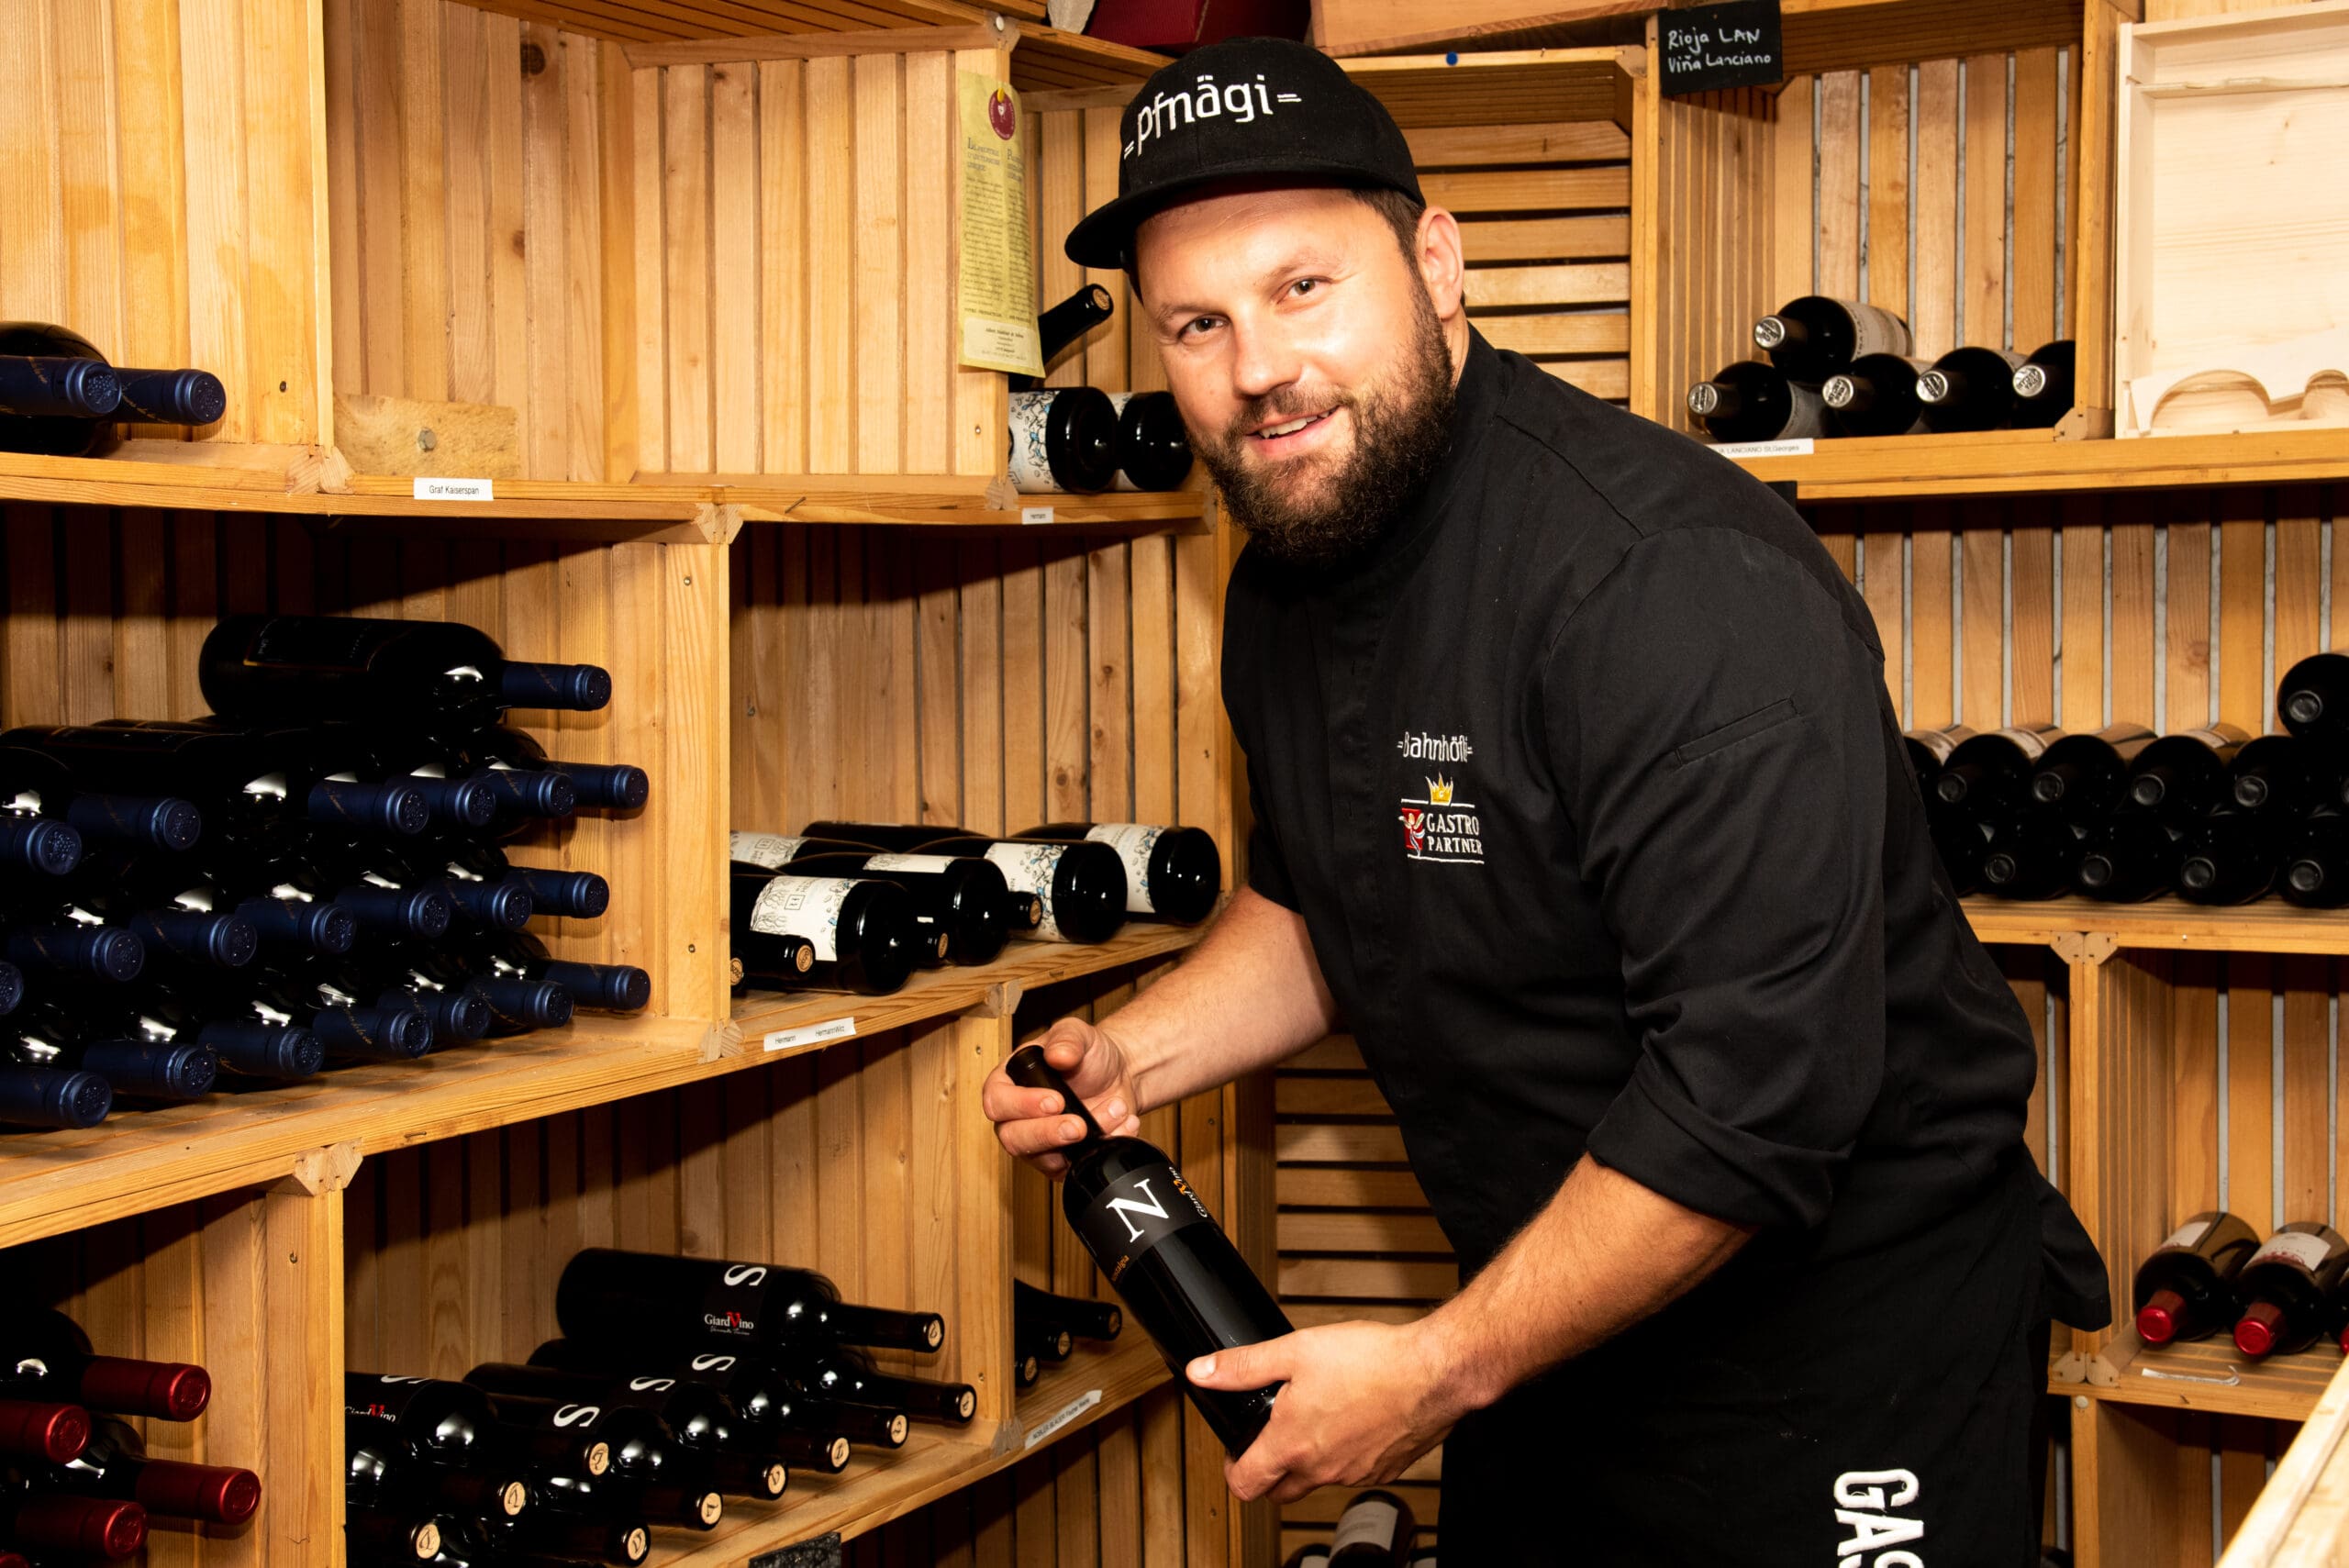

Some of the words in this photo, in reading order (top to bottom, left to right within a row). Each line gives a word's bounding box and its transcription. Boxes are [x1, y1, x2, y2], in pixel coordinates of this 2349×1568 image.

[1668, 27, 1709, 54] Rioja
[1719, 28, 1760, 44] LAN
[1668, 55, 1701, 72] Viña
[1706, 50, 1772, 67] Lanciano
[429, 484, 444, 494] Graf
[1426, 813, 1480, 836] GASTRO
[1427, 836, 1484, 855] PARTNER
[1105, 1178, 1169, 1243] N
[723, 1264, 767, 1286] S
[704, 1311, 754, 1329] GiardVino
[692, 1353, 736, 1371] S
[629, 1376, 676, 1392] S
[553, 1404, 600, 1428] S
